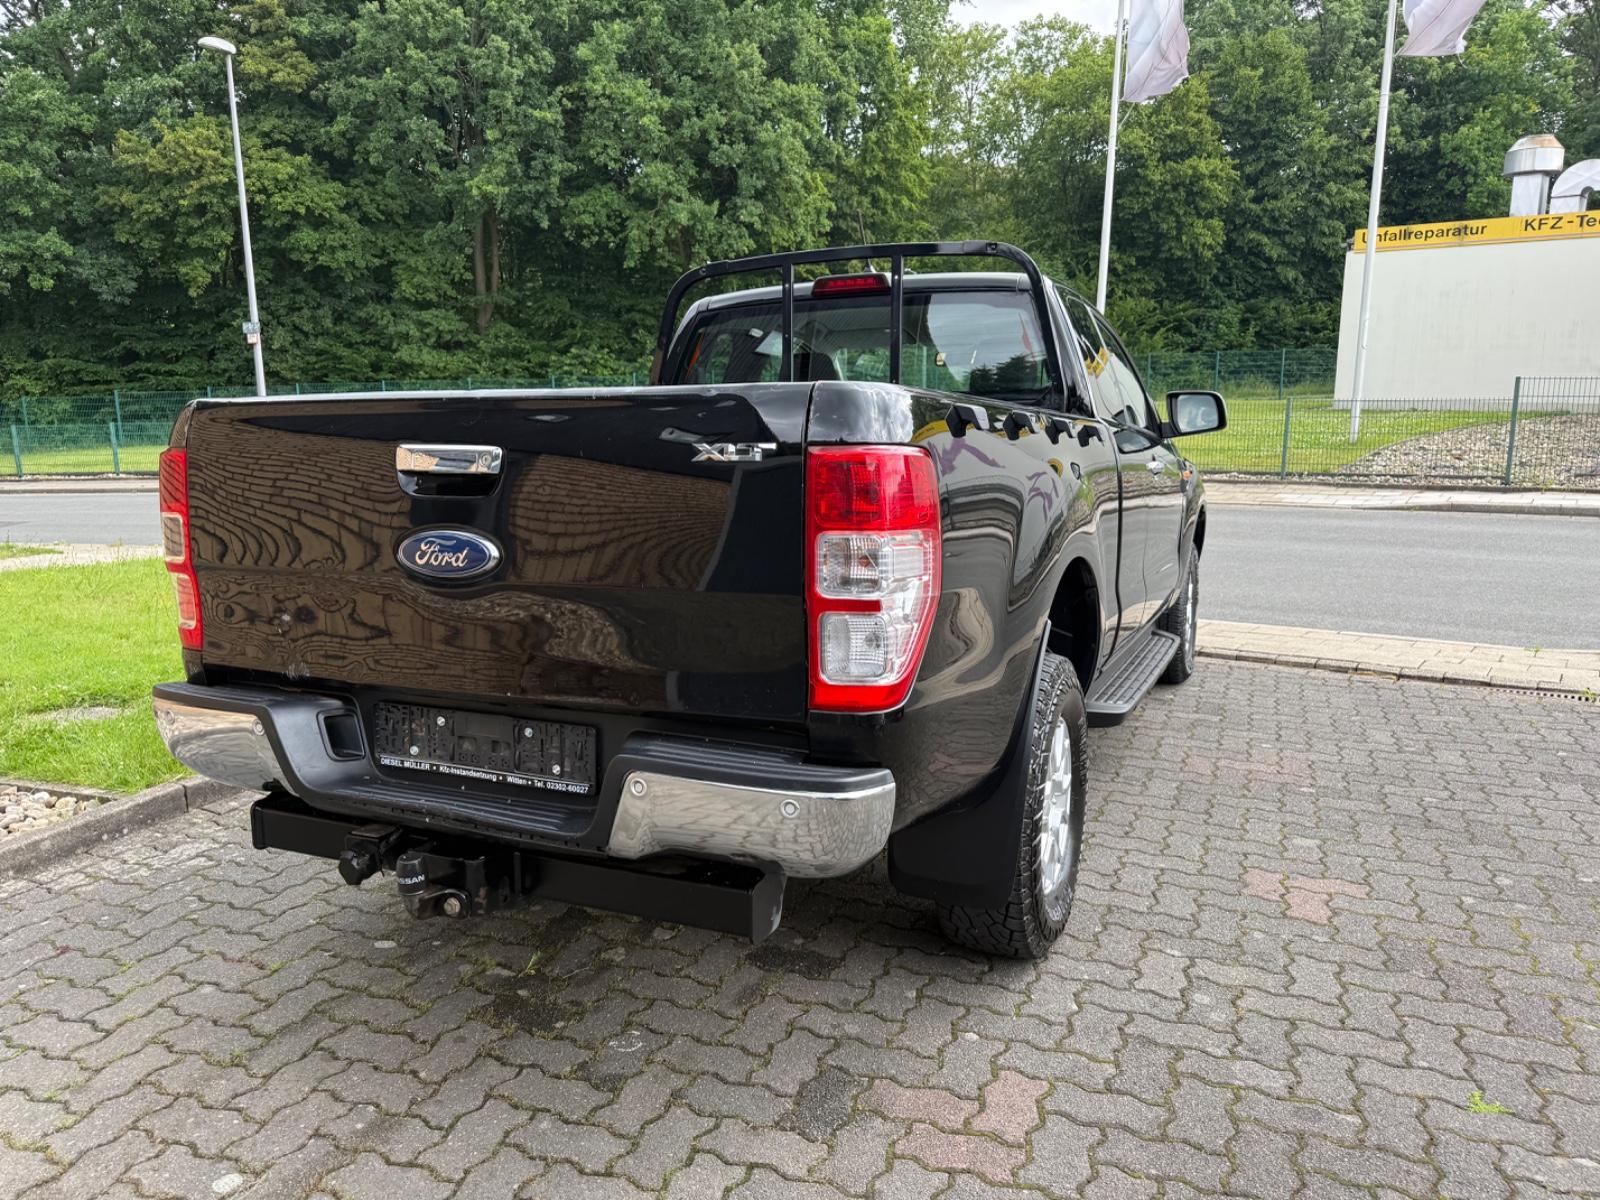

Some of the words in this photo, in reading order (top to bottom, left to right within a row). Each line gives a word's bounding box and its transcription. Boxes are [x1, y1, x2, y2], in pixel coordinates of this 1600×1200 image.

[1524, 214, 1600, 231] KFZ-Te
[691, 442, 777, 462] XLT
[415, 537, 470, 567] Ford
[380, 757, 403, 767] DIESEL
[404, 760, 431, 771] MÜLLER
